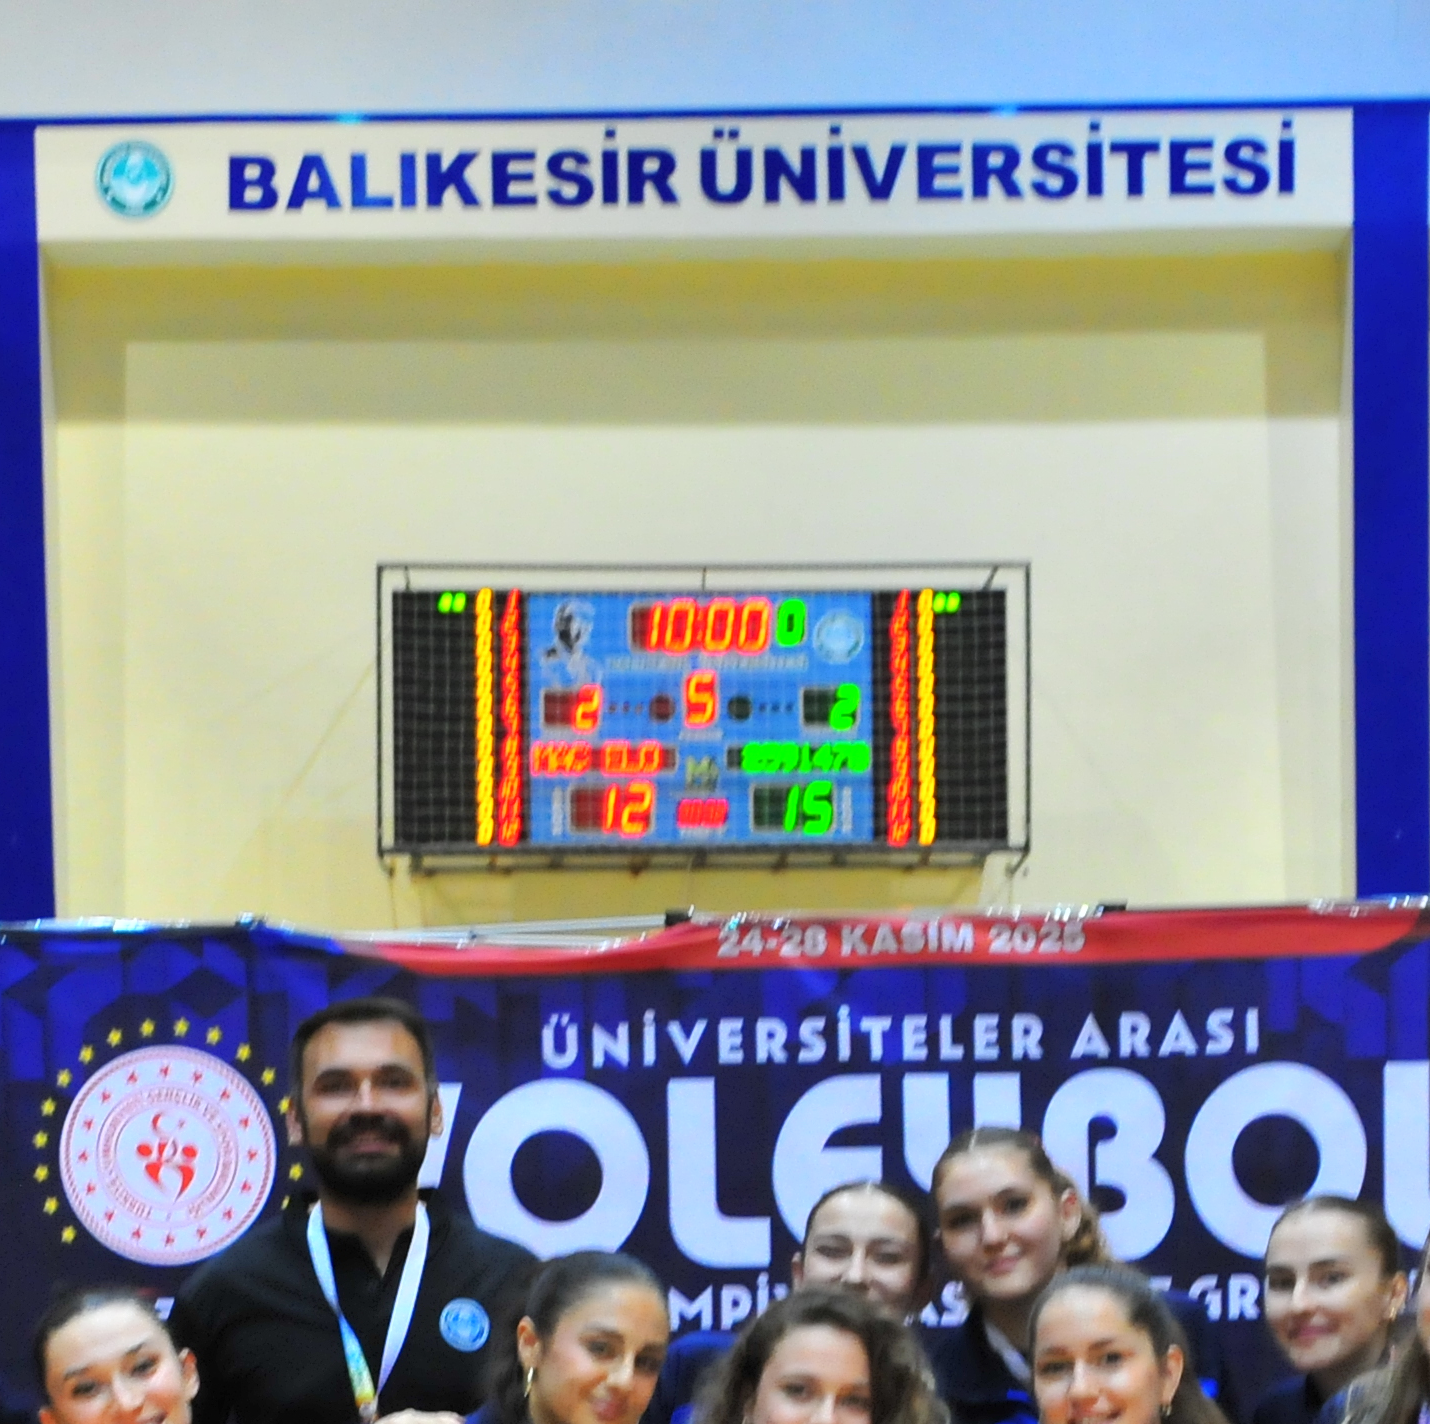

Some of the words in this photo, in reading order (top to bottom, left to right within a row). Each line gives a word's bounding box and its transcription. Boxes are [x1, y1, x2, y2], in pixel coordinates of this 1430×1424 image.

[227, 127, 679, 214] BALIKESİR
[702, 117, 1297, 206] ÜNİVERSİTESİ
[683, 667, 718, 729] 5
[828, 682, 861, 732] 2
[602, 778, 655, 839] 12
[782, 778, 834, 836] 15
[540, 1004, 1046, 1069] ÜNİVERSİTELER
[1070, 1006, 1261, 1059] ARASI
